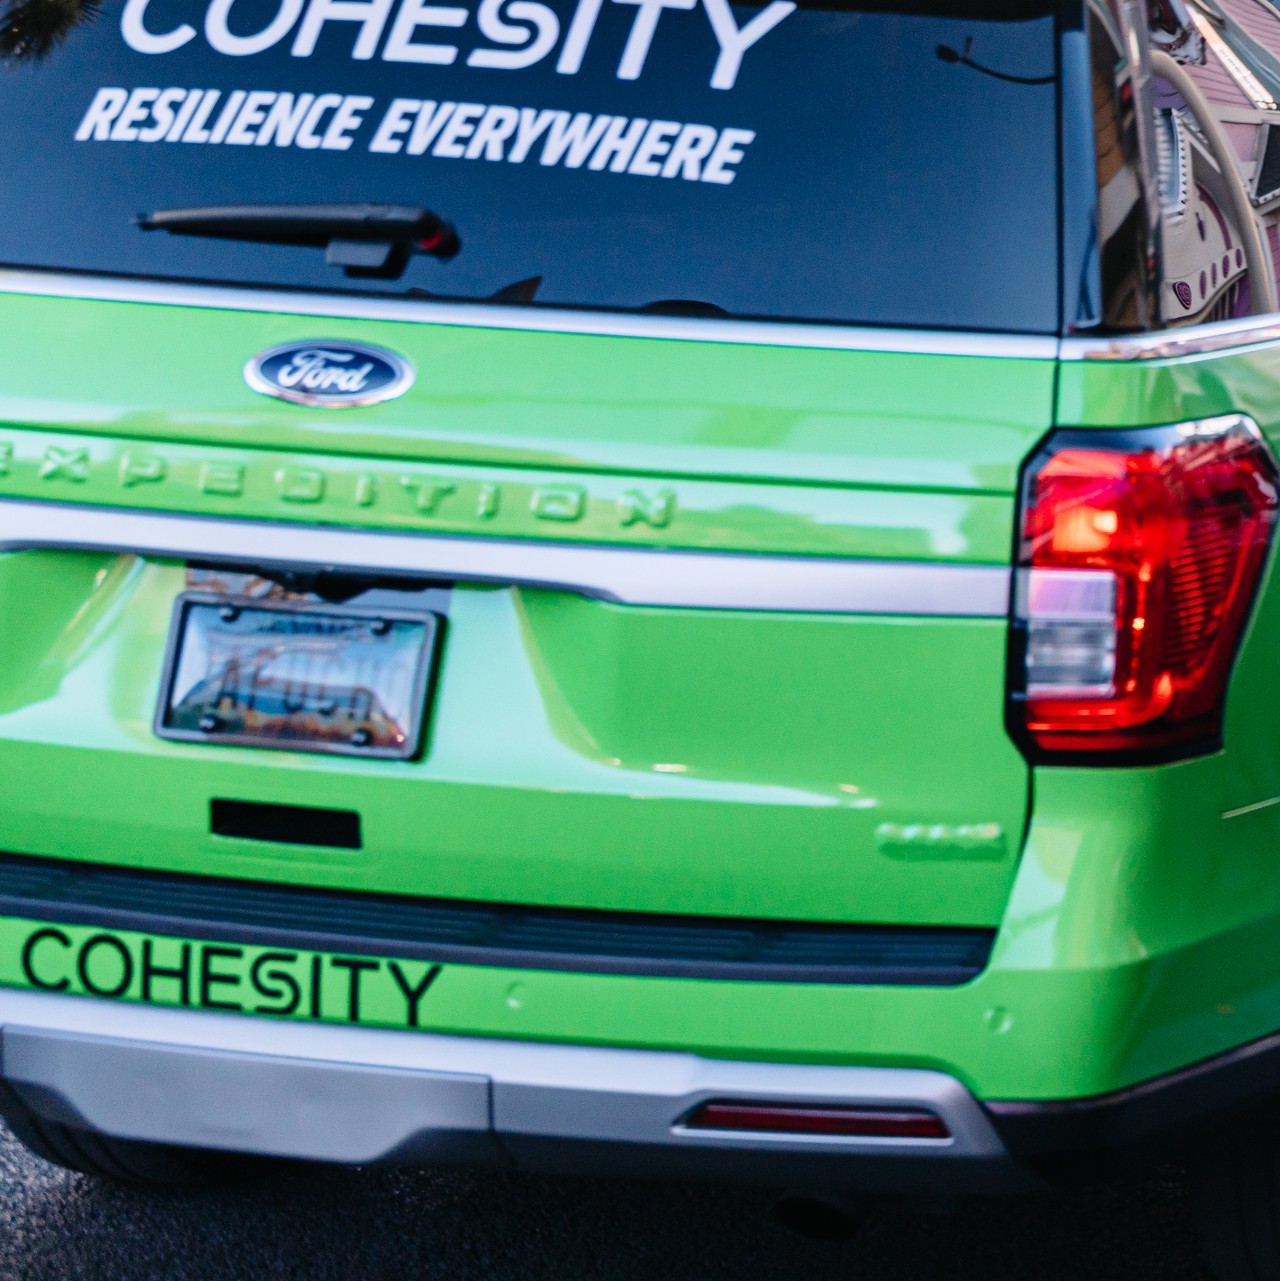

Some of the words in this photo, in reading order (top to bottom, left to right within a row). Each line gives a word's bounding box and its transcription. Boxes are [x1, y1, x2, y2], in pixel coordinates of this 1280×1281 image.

[74, 86, 374, 151] RESILIENCE
[368, 96, 756, 184] EVERYWHERE
[277, 348, 374, 393] Ford
[21, 927, 444, 1028] COHESITY
